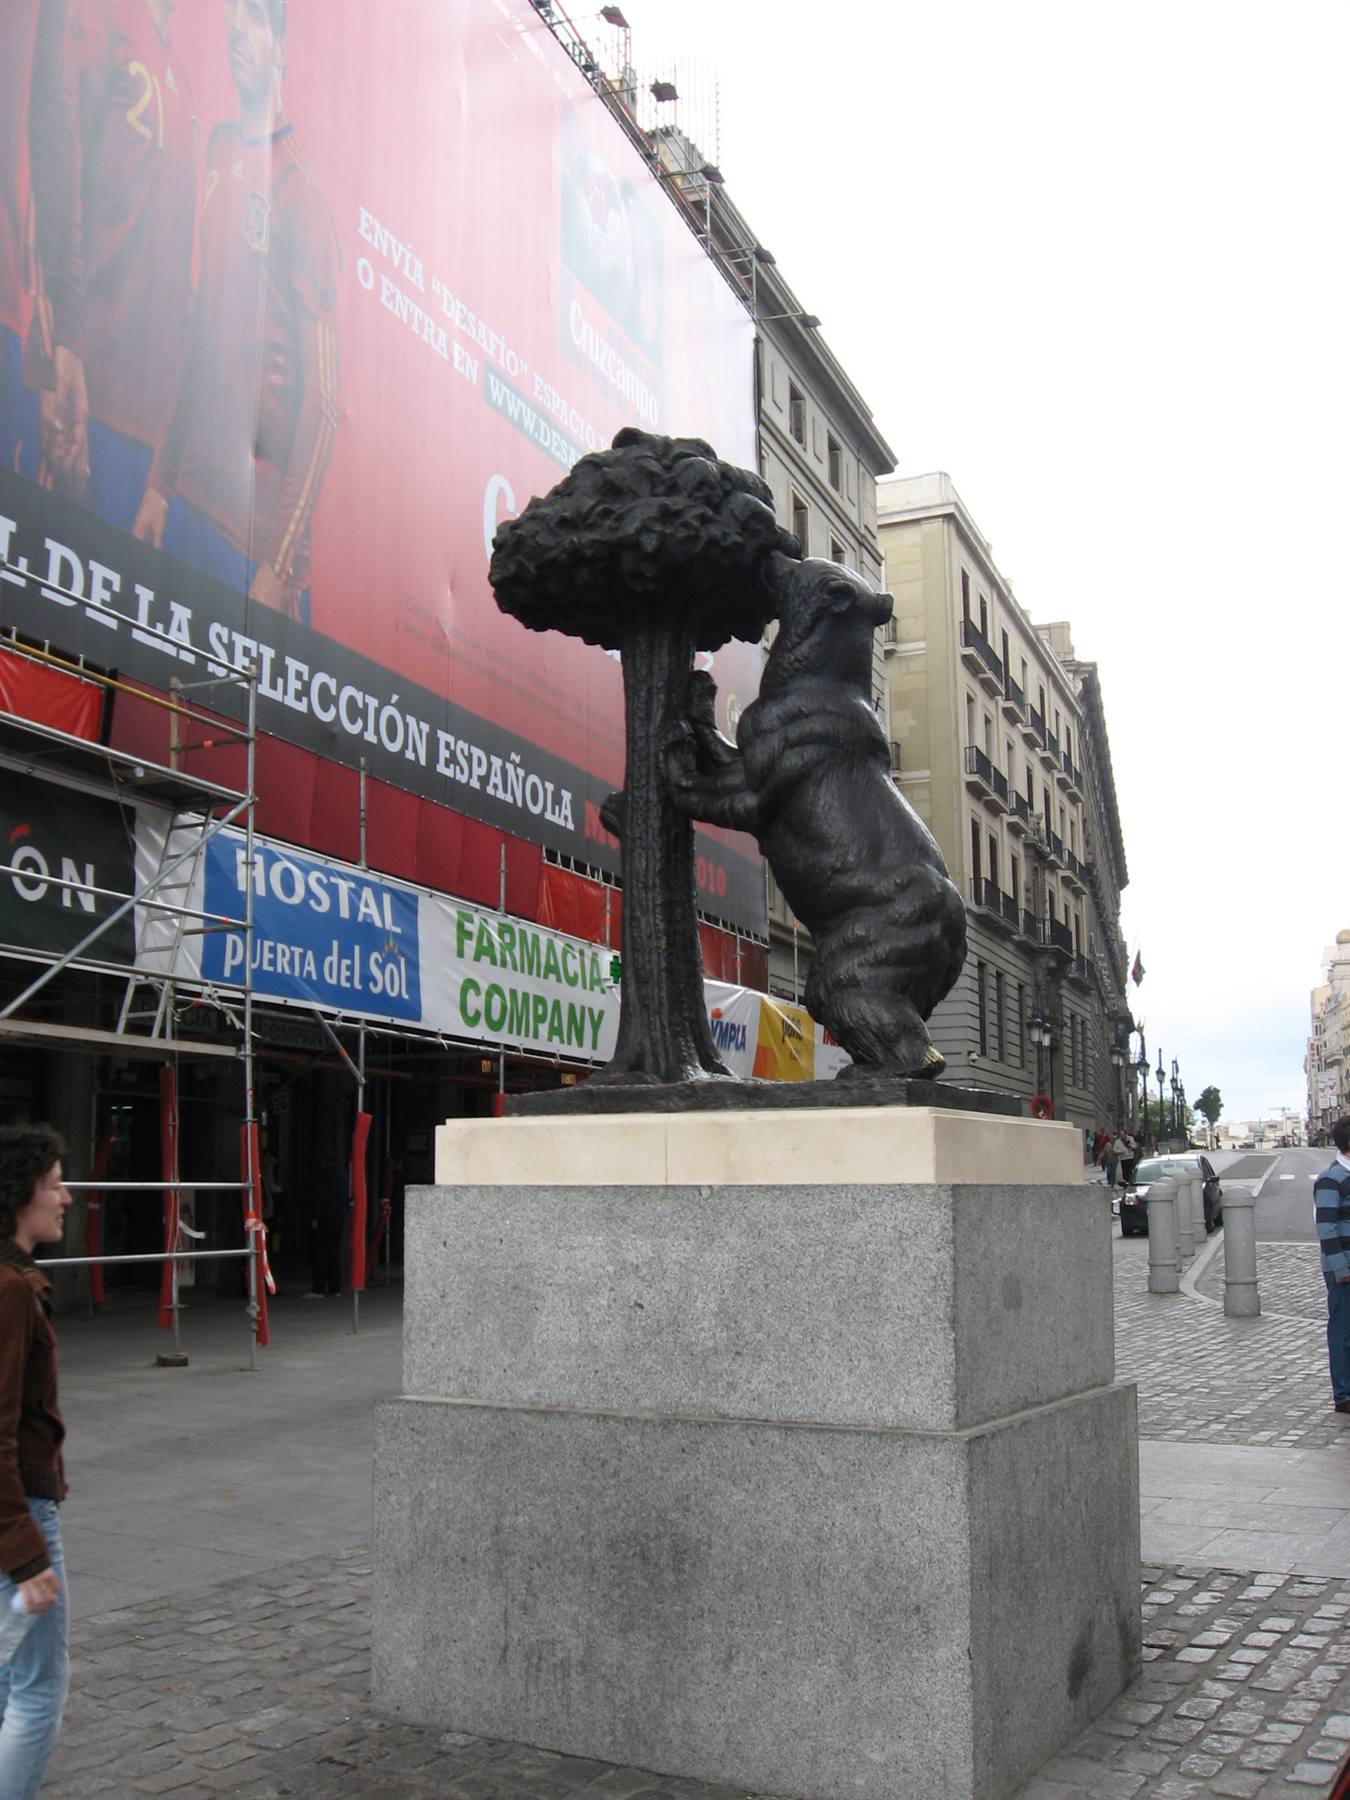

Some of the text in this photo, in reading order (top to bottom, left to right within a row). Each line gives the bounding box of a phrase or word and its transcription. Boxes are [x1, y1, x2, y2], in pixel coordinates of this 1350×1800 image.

[356, 257, 582, 470] O ENTRA EN WWW.DESA
[358, 205, 425, 293] ENVÍA
[532, 371, 597, 450] ESPACIO
[568, 299, 660, 427] Cruzcampo
[41, 537, 121, 631] DE
[131, 583, 196, 665] LA
[207, 621, 430, 767] SELECCIÓN
[436, 728, 574, 832] ESPAÑOLA
[236, 848, 402, 934] HOSTAL
[369, 950, 410, 1000] Sol
[456, 910, 606, 995] FARMACIA
[460, 977, 605, 1051] COMPANY
